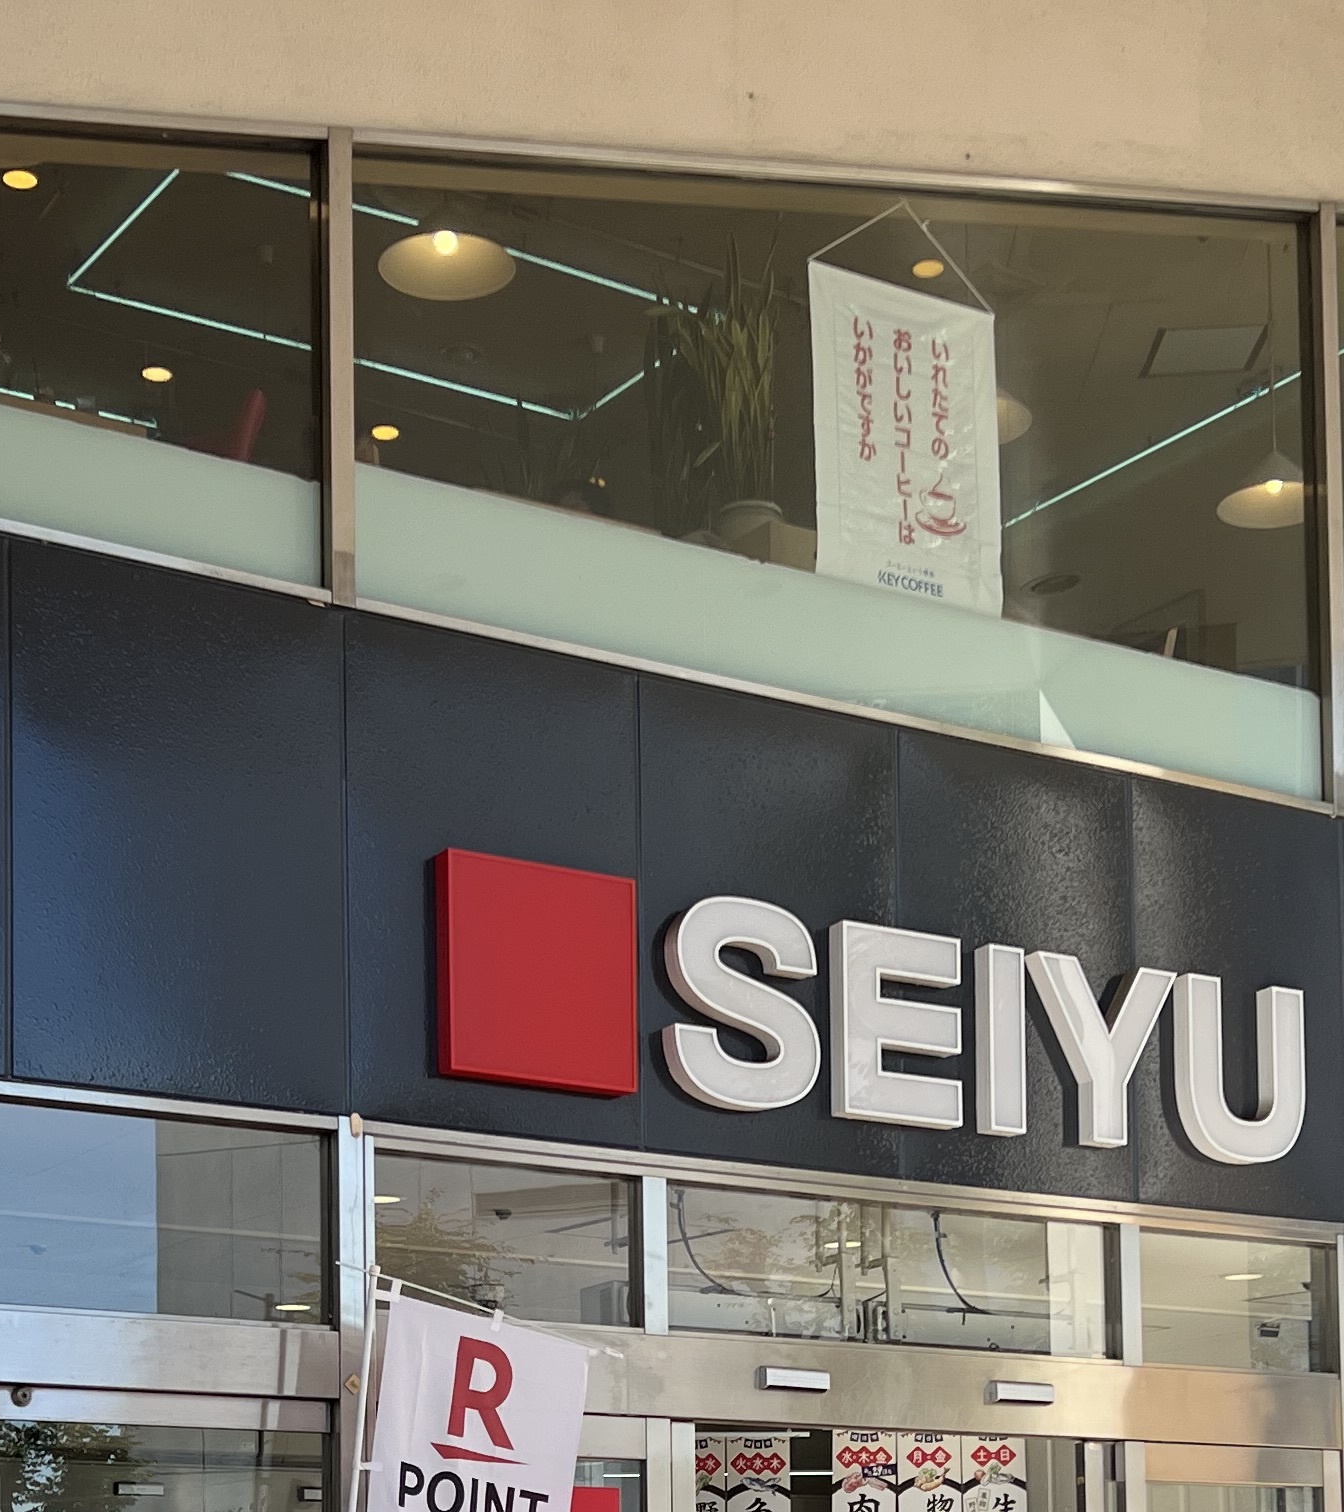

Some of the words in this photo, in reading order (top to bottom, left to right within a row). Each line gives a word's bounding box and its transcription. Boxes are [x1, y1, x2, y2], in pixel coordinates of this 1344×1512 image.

[852, 315, 877, 462] いかがですか
[892, 328, 916, 545] おいしいコーヒーは
[931, 338, 950, 461] いれたての
[876, 570, 901, 591] KEY
[900, 574, 945, 598] COFFEE
[662, 895, 1306, 1166] SEIYU
